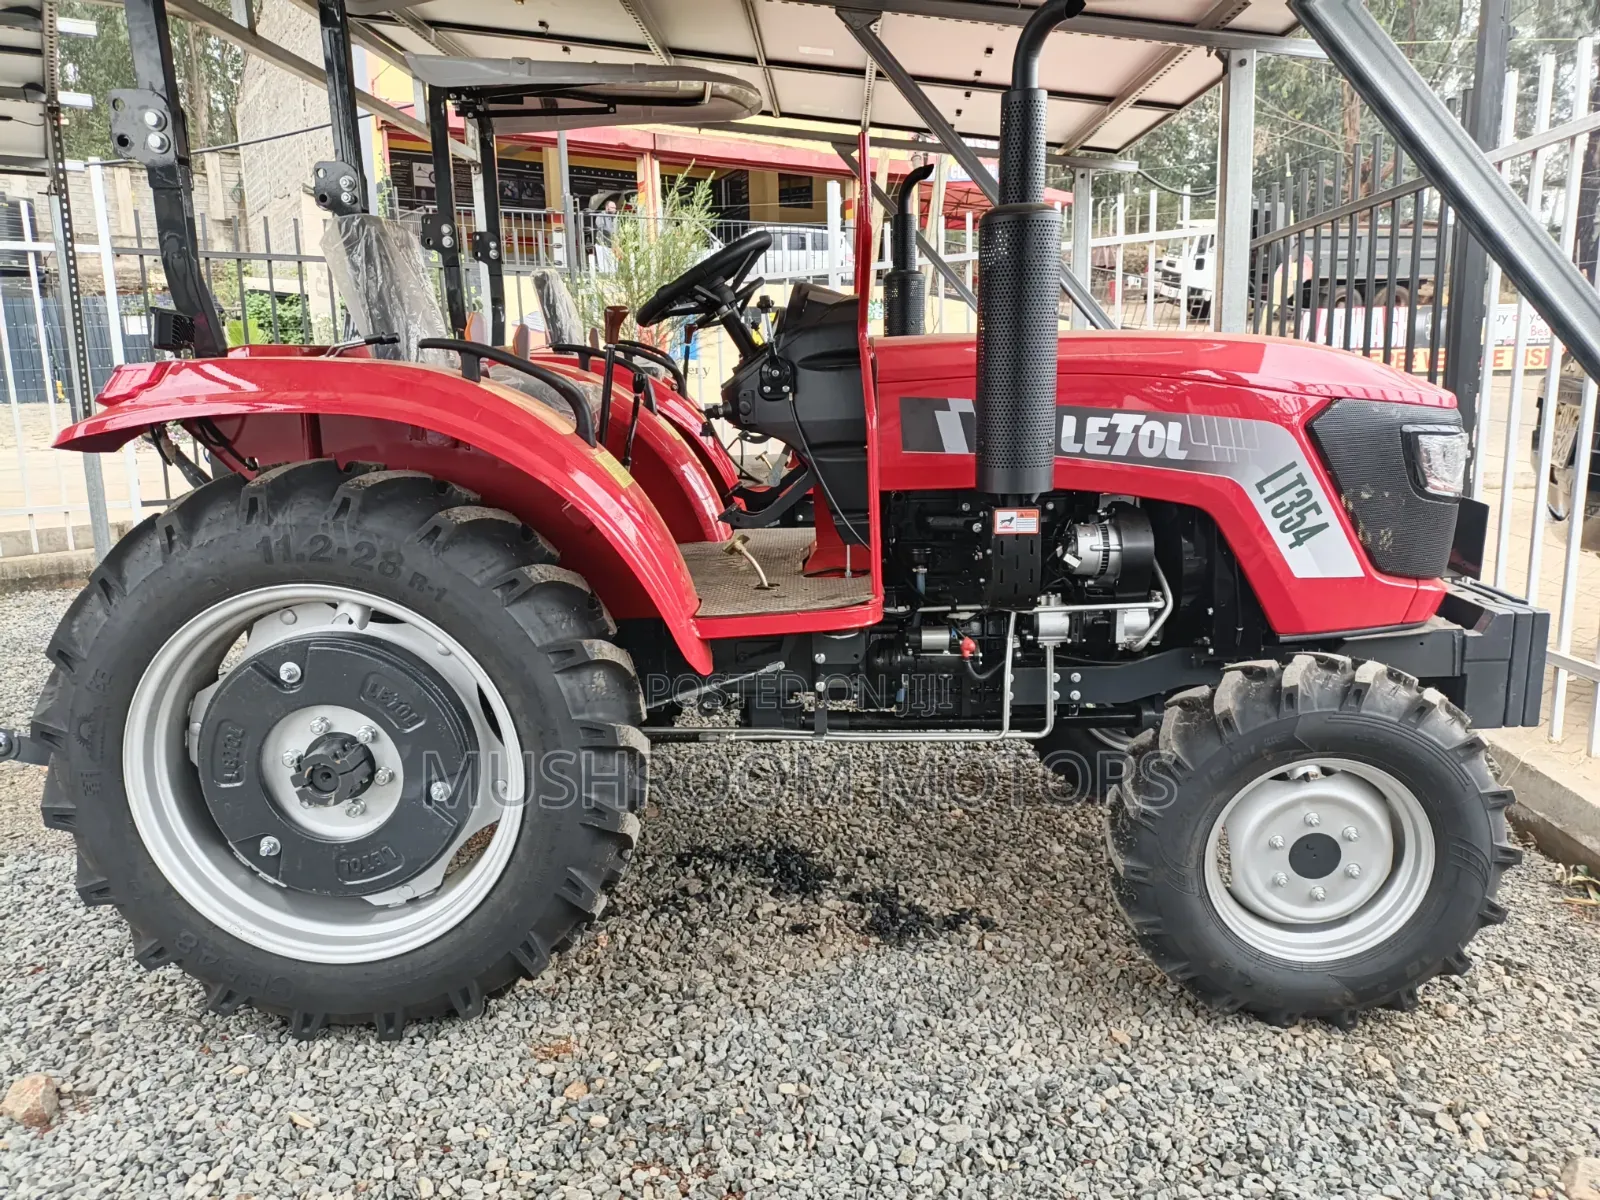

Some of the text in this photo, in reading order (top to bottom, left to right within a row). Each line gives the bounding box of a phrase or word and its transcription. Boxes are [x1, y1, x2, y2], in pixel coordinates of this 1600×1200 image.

[1060, 413, 1188, 460] LETOL
[1255, 460, 1330, 550] LT354
[255, 533, 405, 579] 11.2-28
